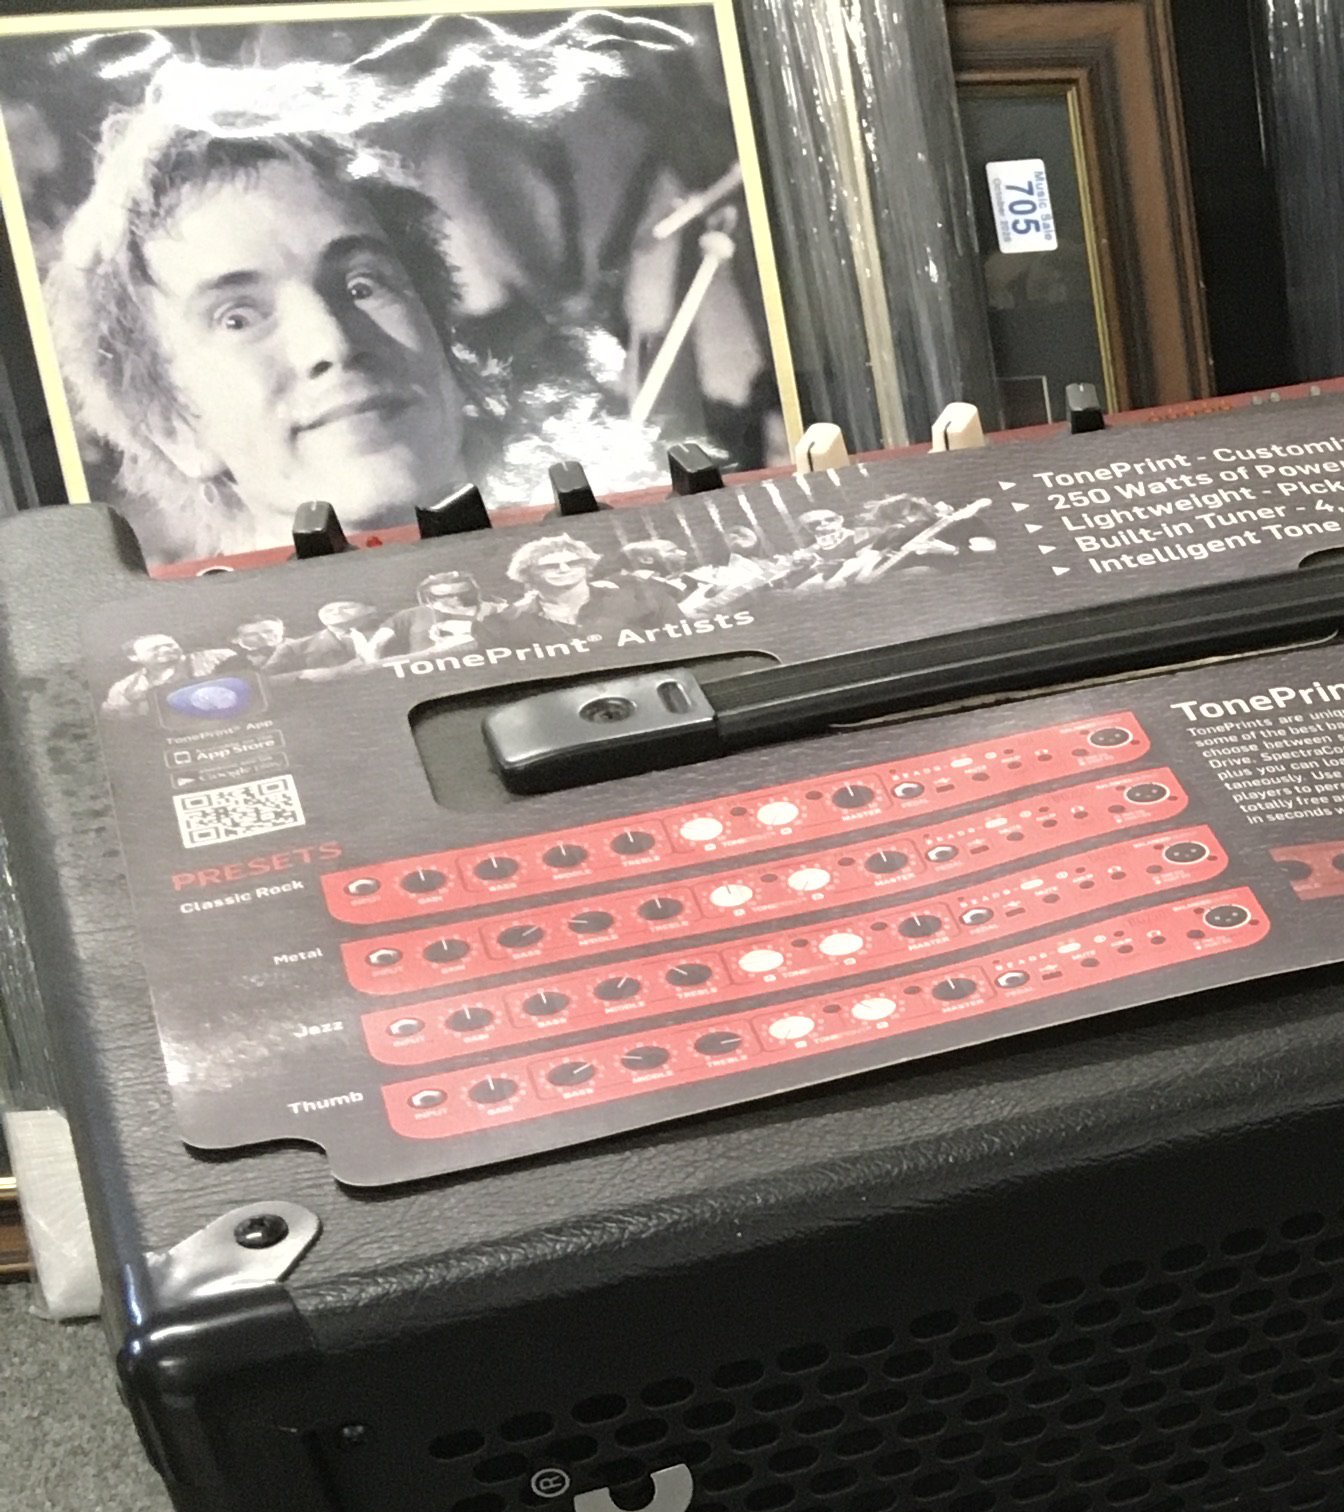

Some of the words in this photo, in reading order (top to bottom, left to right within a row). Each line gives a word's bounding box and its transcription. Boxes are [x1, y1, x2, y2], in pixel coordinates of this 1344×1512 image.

[1005, 180, 1041, 235] 705
[1034, 170, 1048, 210] Music
[1041, 213, 1055, 241] Sale
[1033, 453, 1192, 488] TonePrint
[1047, 488, 1111, 510] 250
[1114, 472, 1214, 499] Watts
[1219, 466, 1250, 482] of
[1061, 485, 1257, 532] Lightweight
[1074, 522, 1194, 552] Built-in
[1195, 504, 1287, 530] Tuner
[1315, 499, 1344, 513] 4,
[1088, 529, 1262, 574] Intelligent
[1261, 519, 1342, 541] Tone
[617, 609, 755, 648] Artists
[1186, 717, 1273, 737] TonePrints
[1279, 714, 1304, 724] are
[1195, 734, 1239, 748] some
[1241, 730, 1257, 740] of
[1260, 728, 1287, 738] the
[1289, 723, 1325, 735] best
[197, 749, 231, 761] App
[232, 739, 275, 753] Store
[1202, 744, 1259, 758] choose
[1263, 734, 1333, 750] between
[1208, 754, 1257, 769] Drive,
[1217, 767, 1253, 781] plus
[1256, 763, 1286, 775] you
[1290, 759, 1320, 770] can
[1311, 769, 1342, 780] Use
[1232, 785, 1292, 803] players
[1294, 784, 1312, 794] to
[1239, 796, 1293, 813] totally
[1296, 795, 1333, 806] free
[1246, 814, 1264, 824] in
[1266, 807, 1332, 821] seconds
[171, 840, 343, 892] PRESETS
[180, 889, 252, 914] Classic
[255, 879, 305, 898] Rock
[272, 948, 324, 965] Metal
[293, 1020, 344, 1039] Jazz
[287, 1091, 364, 1115] Thumb
